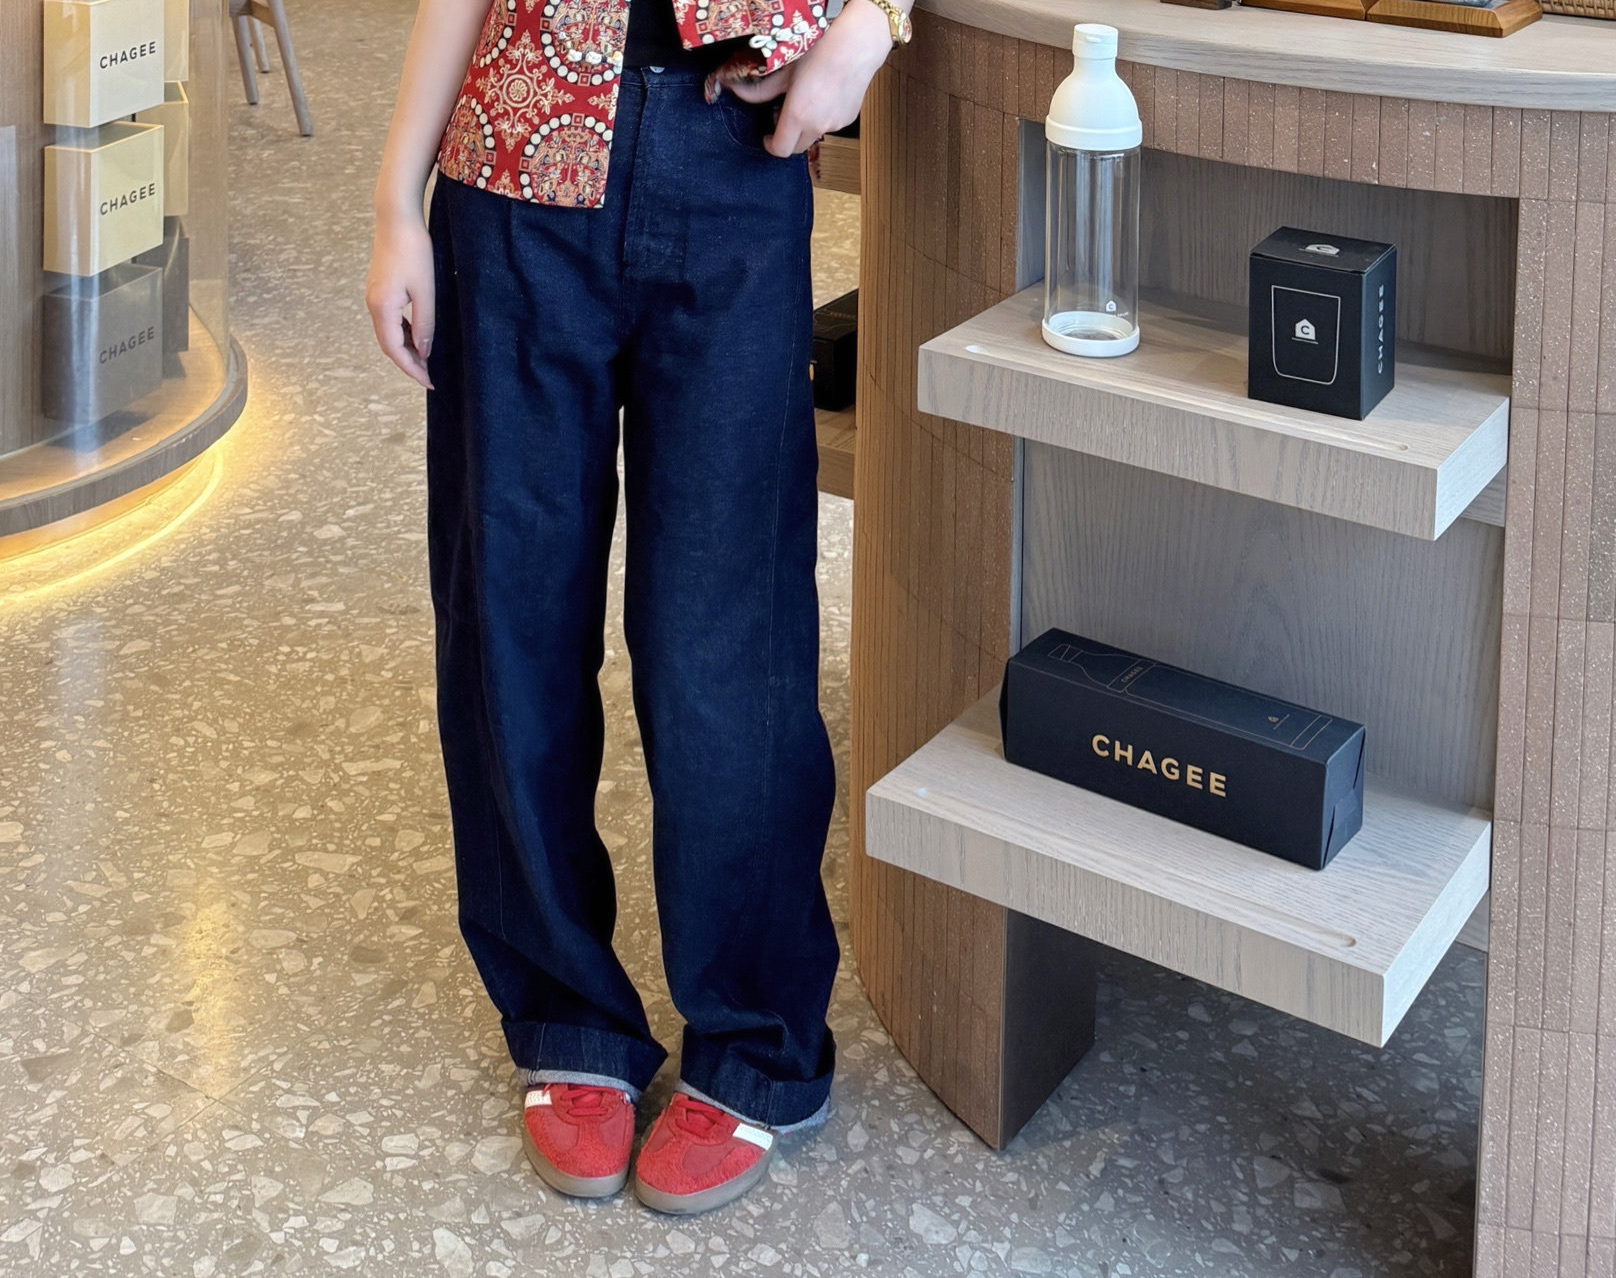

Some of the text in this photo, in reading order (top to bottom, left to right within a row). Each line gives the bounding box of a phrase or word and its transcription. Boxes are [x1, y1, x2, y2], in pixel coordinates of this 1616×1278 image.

[99, 41, 157, 70] CHAGEE
[99, 182, 157, 216] CHAGEE
[99, 324, 156, 365] CHAGEE
[1301, 325, 1310, 335] C
[1377, 284, 1385, 375] CHAGEE
[1091, 734, 1228, 798] CHAGEE
